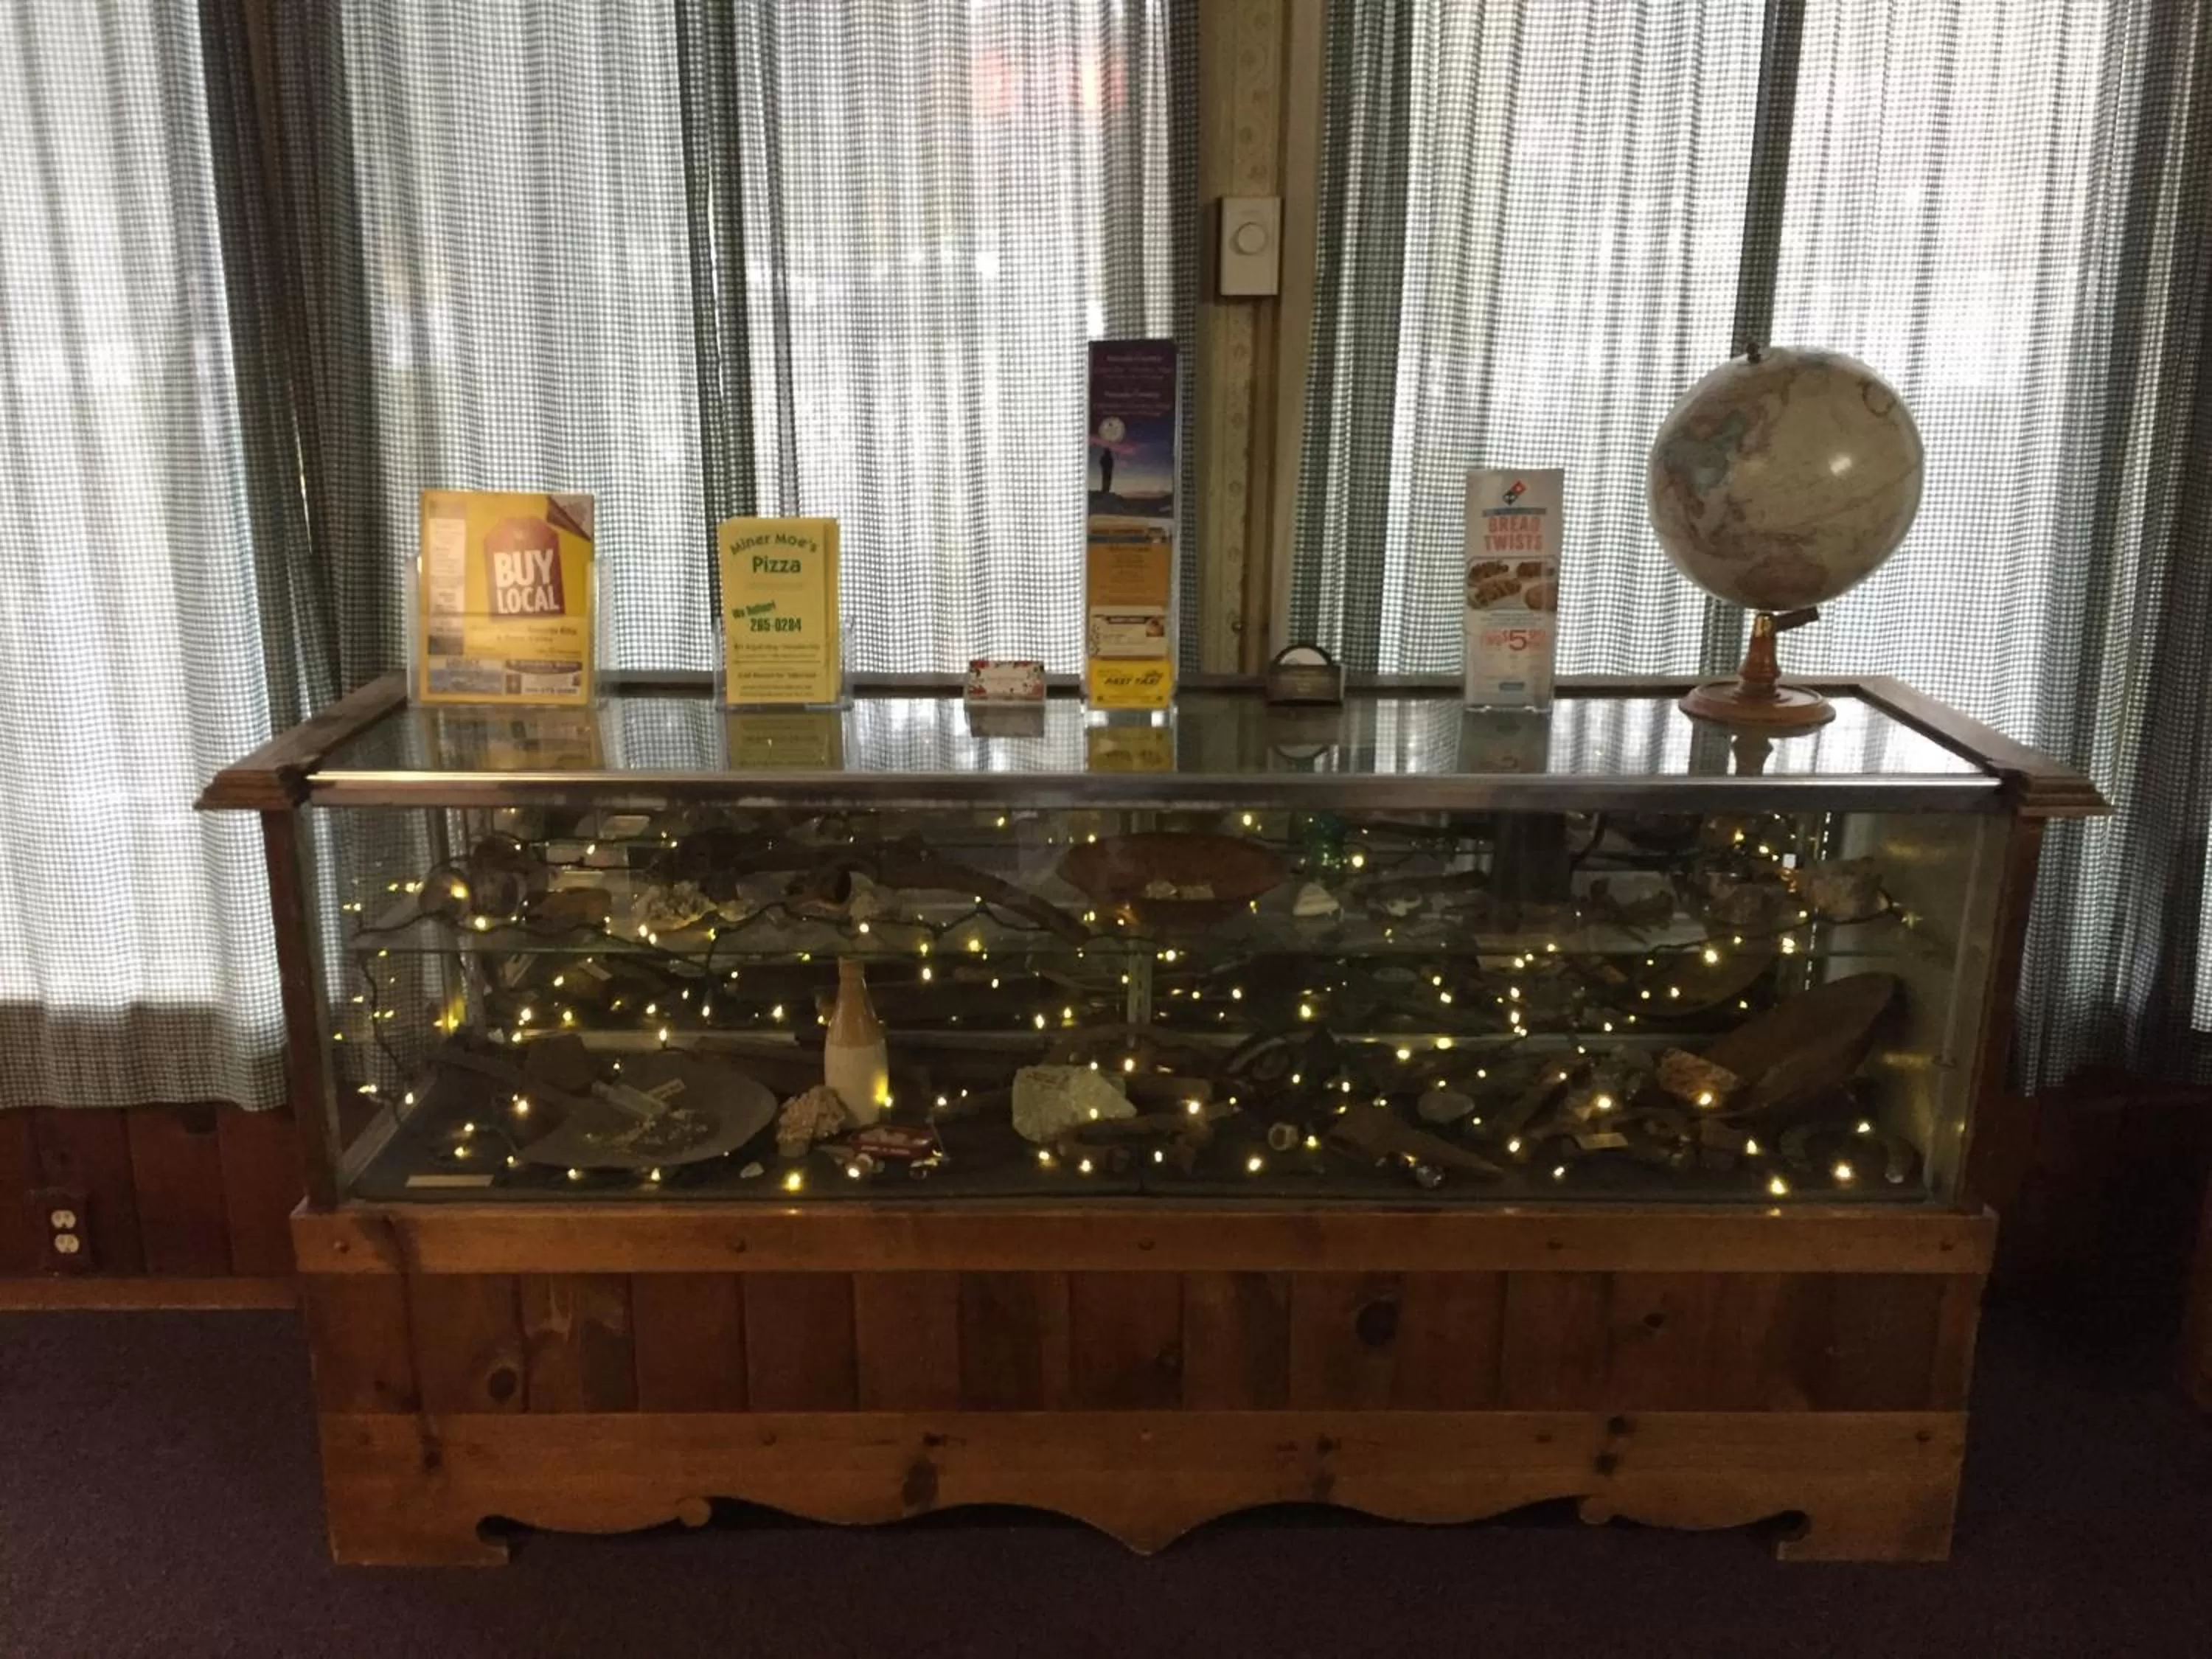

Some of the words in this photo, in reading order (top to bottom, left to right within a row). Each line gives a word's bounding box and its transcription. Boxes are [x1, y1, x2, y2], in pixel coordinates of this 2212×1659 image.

[1489, 516, 1541, 532] BREAD
[730, 535, 769, 555] Miner
[776, 533, 817, 553] Moe's
[1484, 534, 1543, 552] TWISTS
[494, 549, 554, 588] BUY
[752, 555, 801, 574] Pizza
[497, 585, 560, 614] LOCAL
